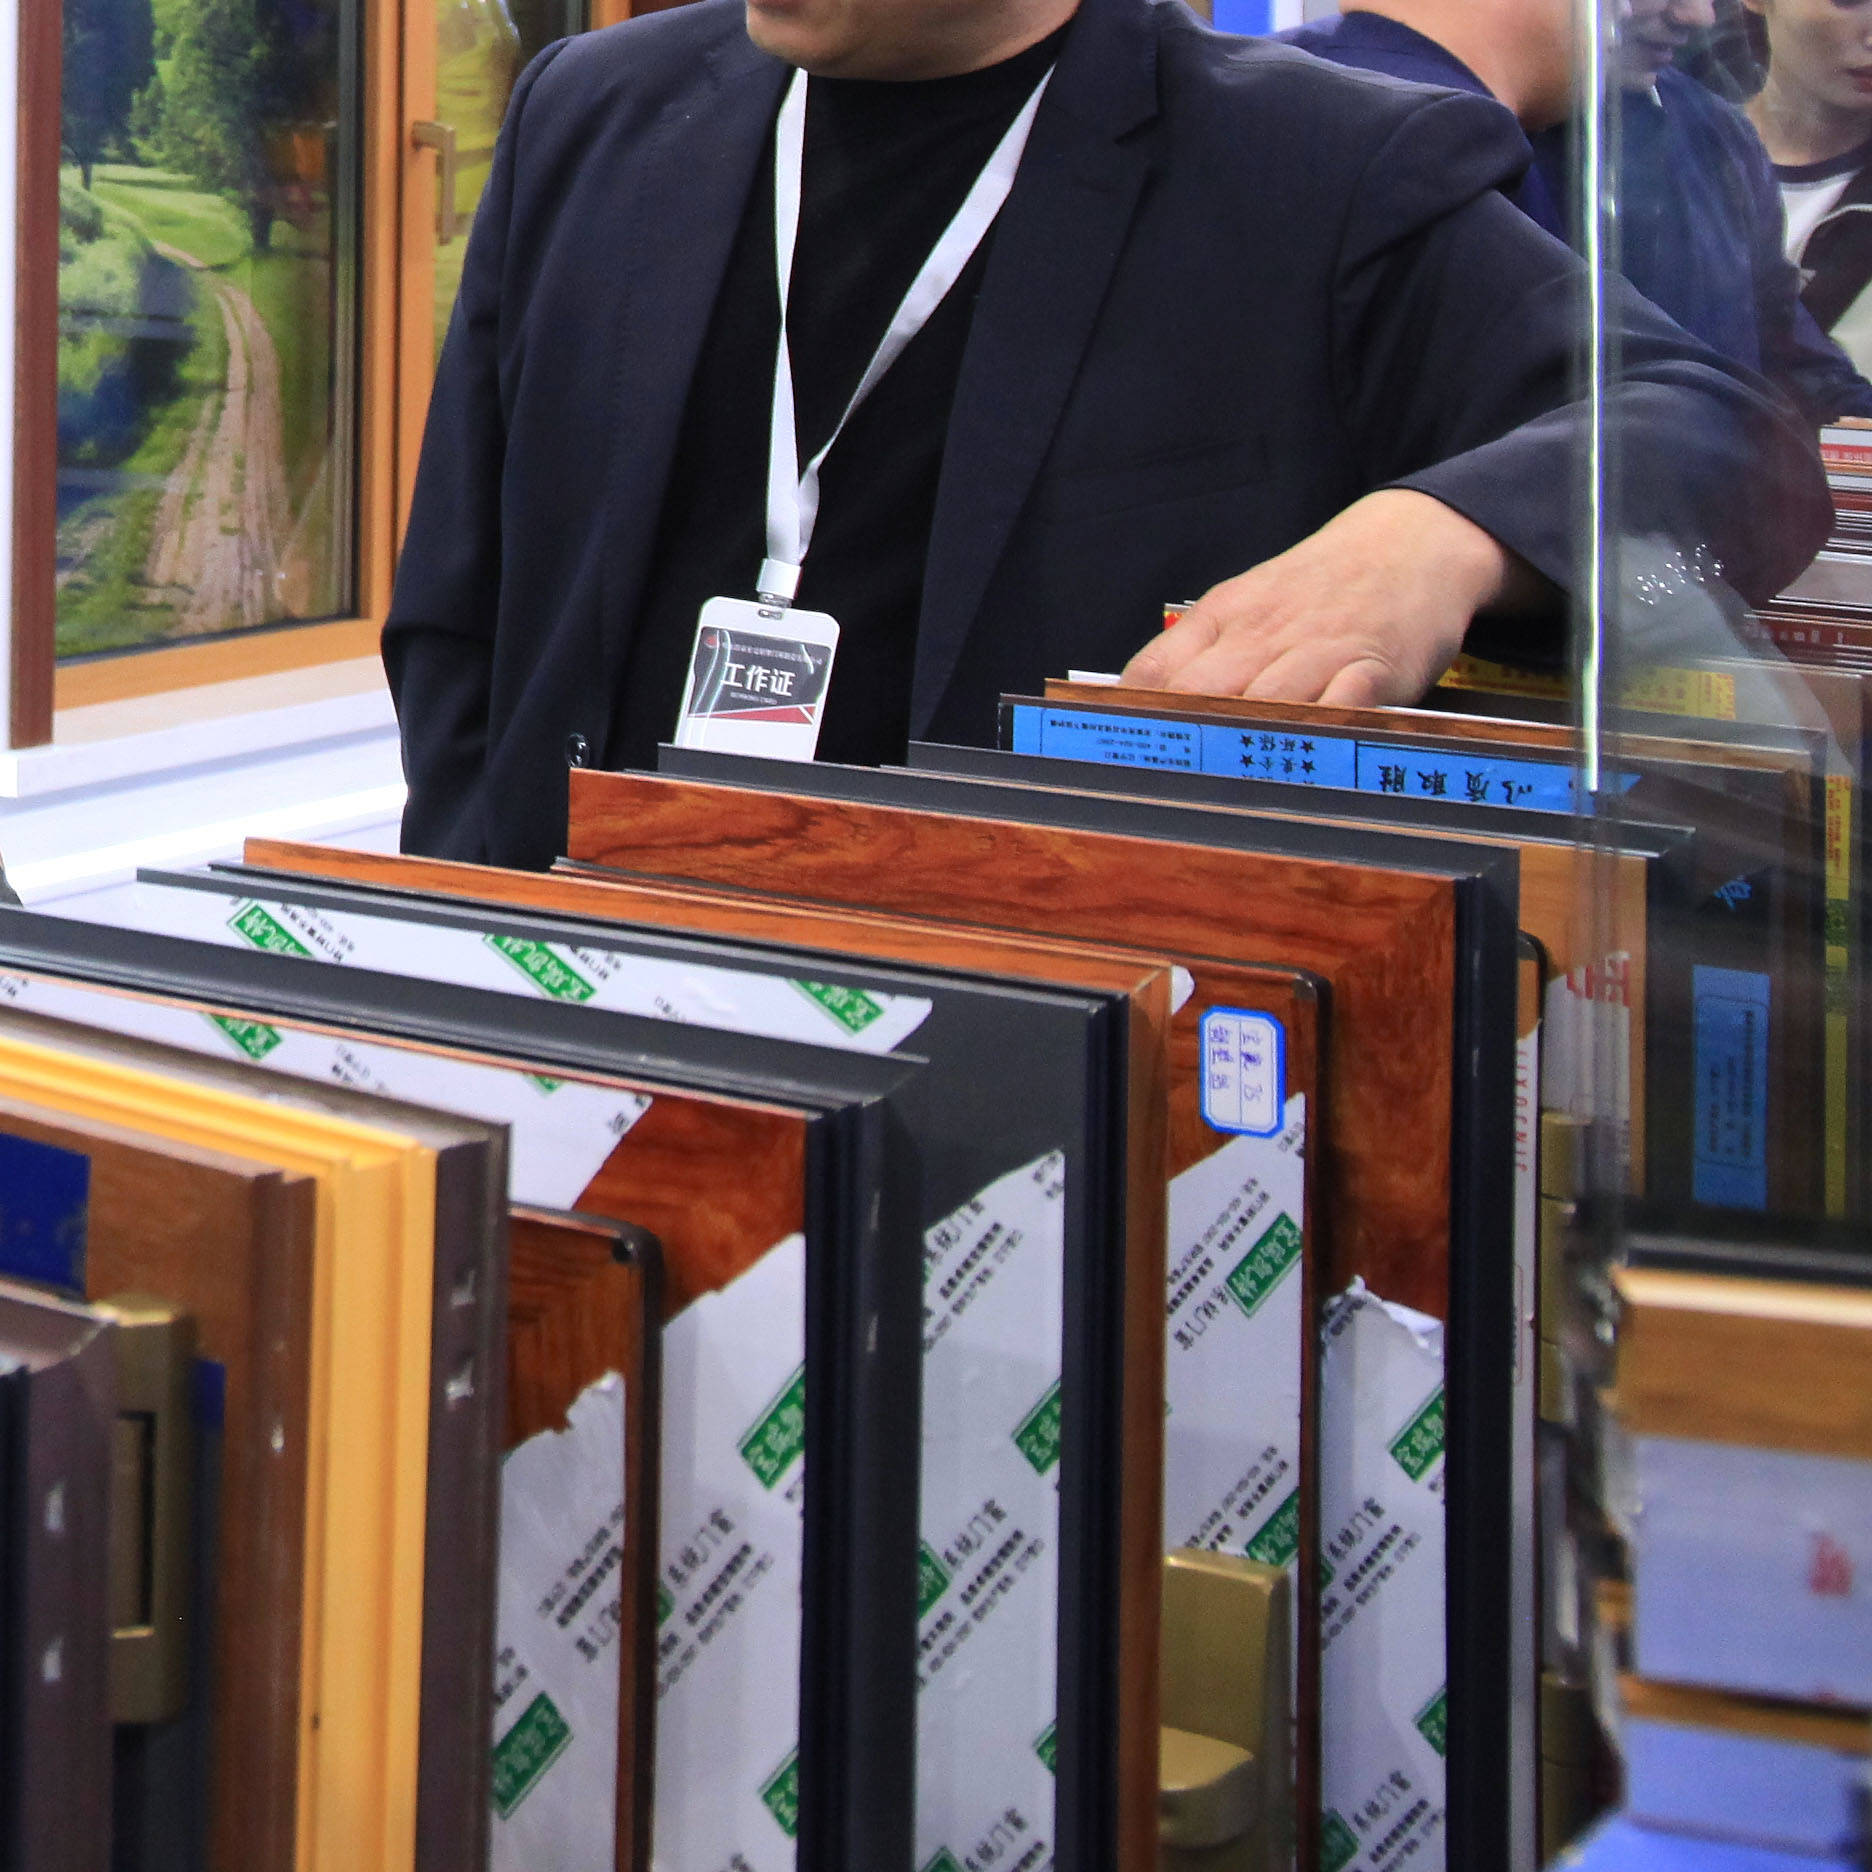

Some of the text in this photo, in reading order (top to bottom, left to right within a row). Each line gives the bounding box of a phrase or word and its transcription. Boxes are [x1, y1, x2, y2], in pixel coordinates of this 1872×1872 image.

[723, 661, 797, 697] 工作证
[1377, 764, 1534, 806] 以质取胜
